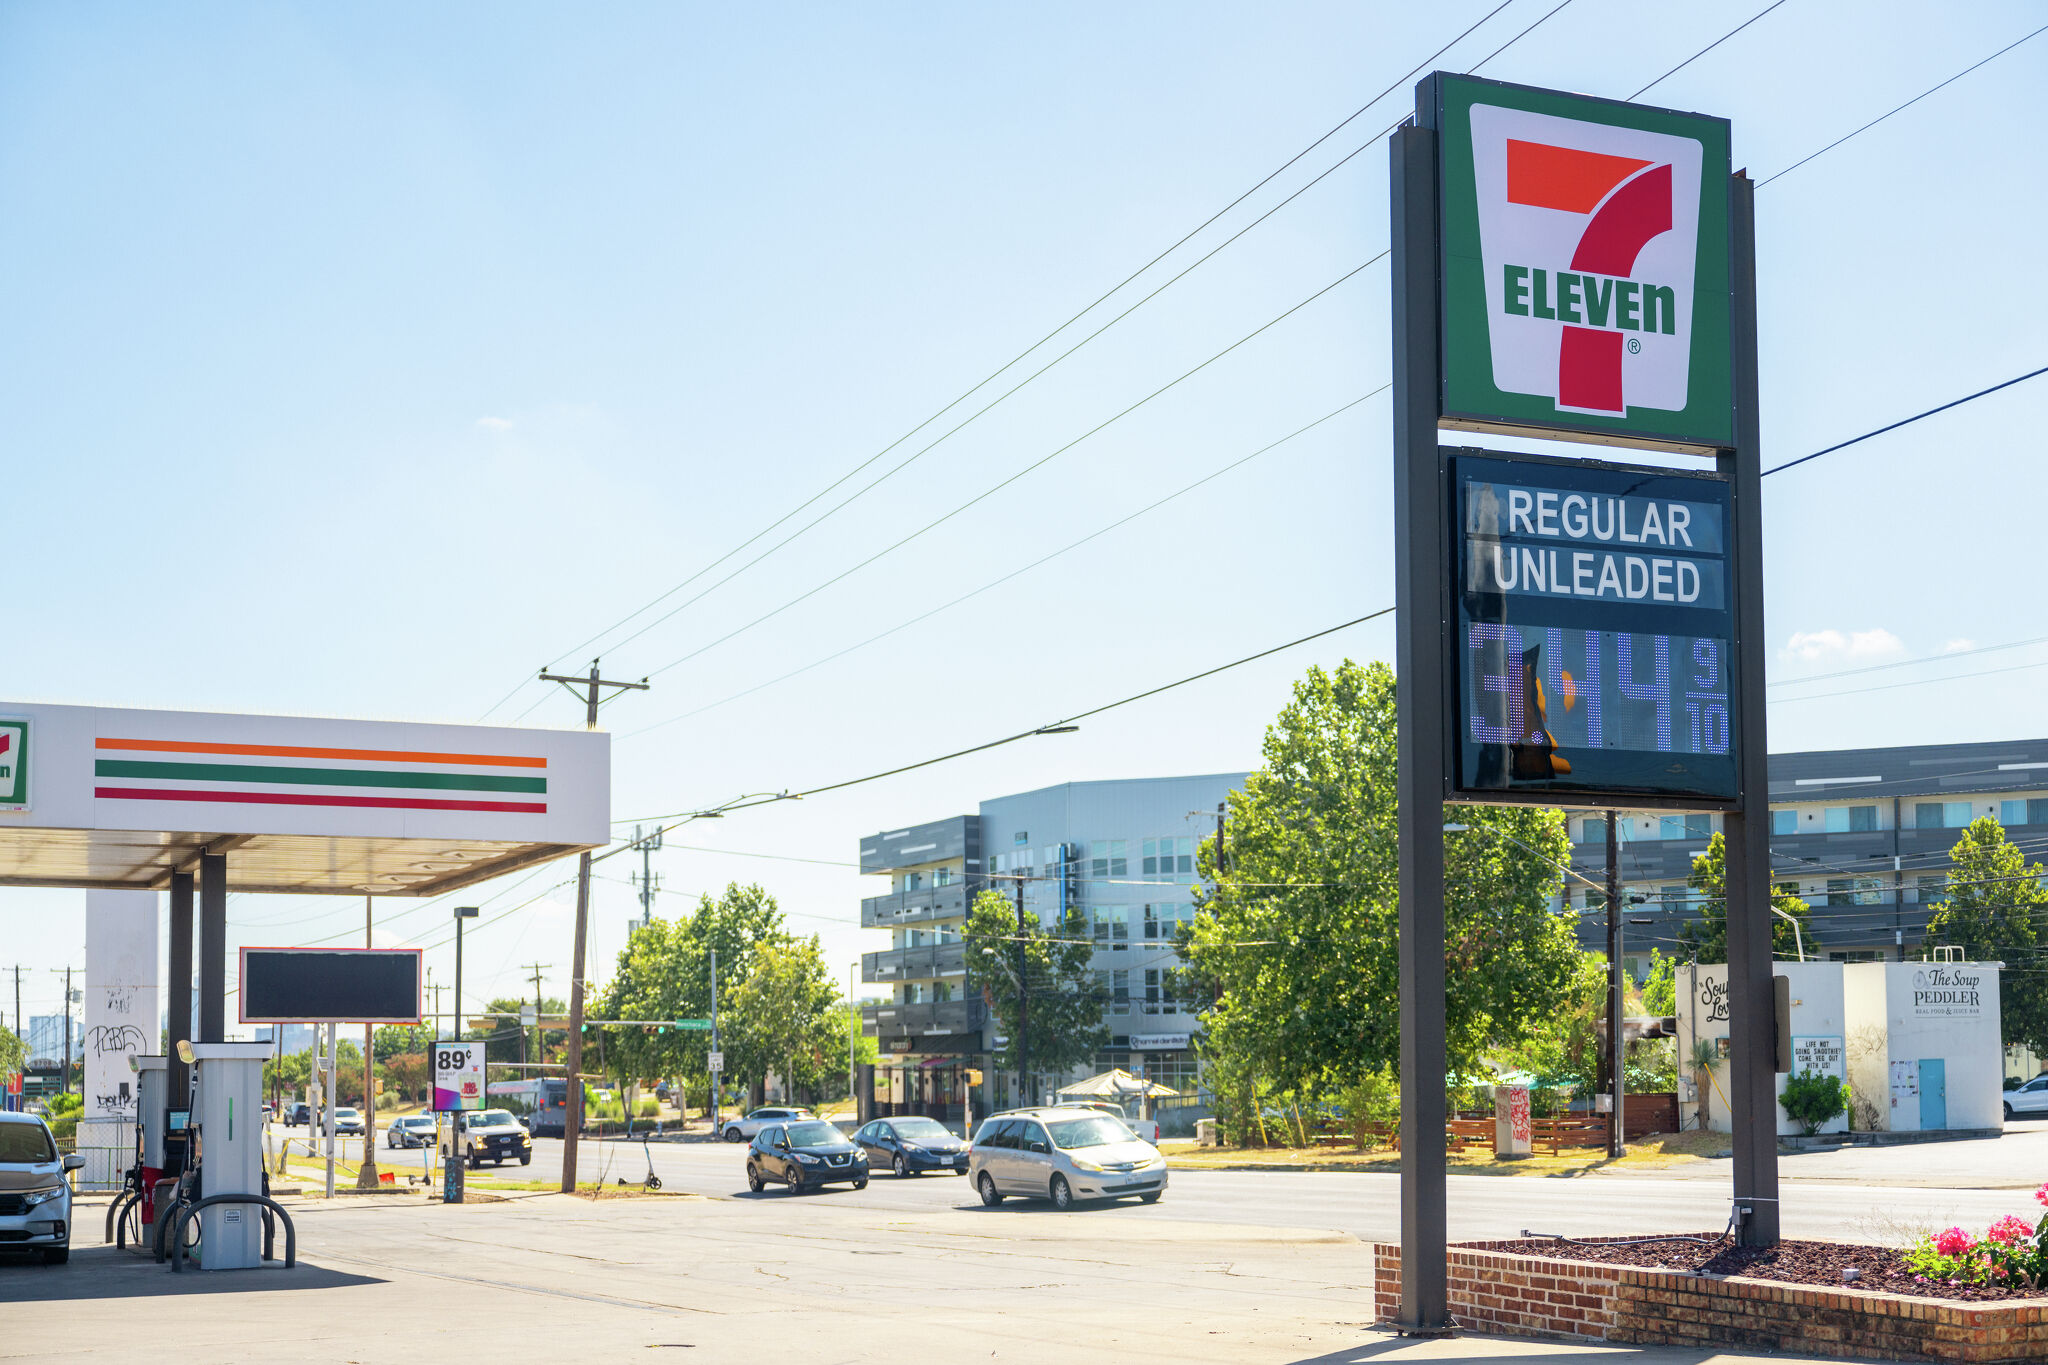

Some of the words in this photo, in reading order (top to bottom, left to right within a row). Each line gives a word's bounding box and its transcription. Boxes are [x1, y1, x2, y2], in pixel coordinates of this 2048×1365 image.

[1507, 138, 1673, 413] 7
[1508, 489, 1693, 547] REGULAR
[1493, 545, 1701, 603] UNLEADED
[1469, 622, 1672, 753] 3.44
[1913, 990, 1980, 1006] PEDDLER
[1928, 968, 1951, 986] The
[1952, 970, 1980, 989] Soup
[1945, 1007, 1952, 1015] &
[710, 1062, 722, 1070] 35
